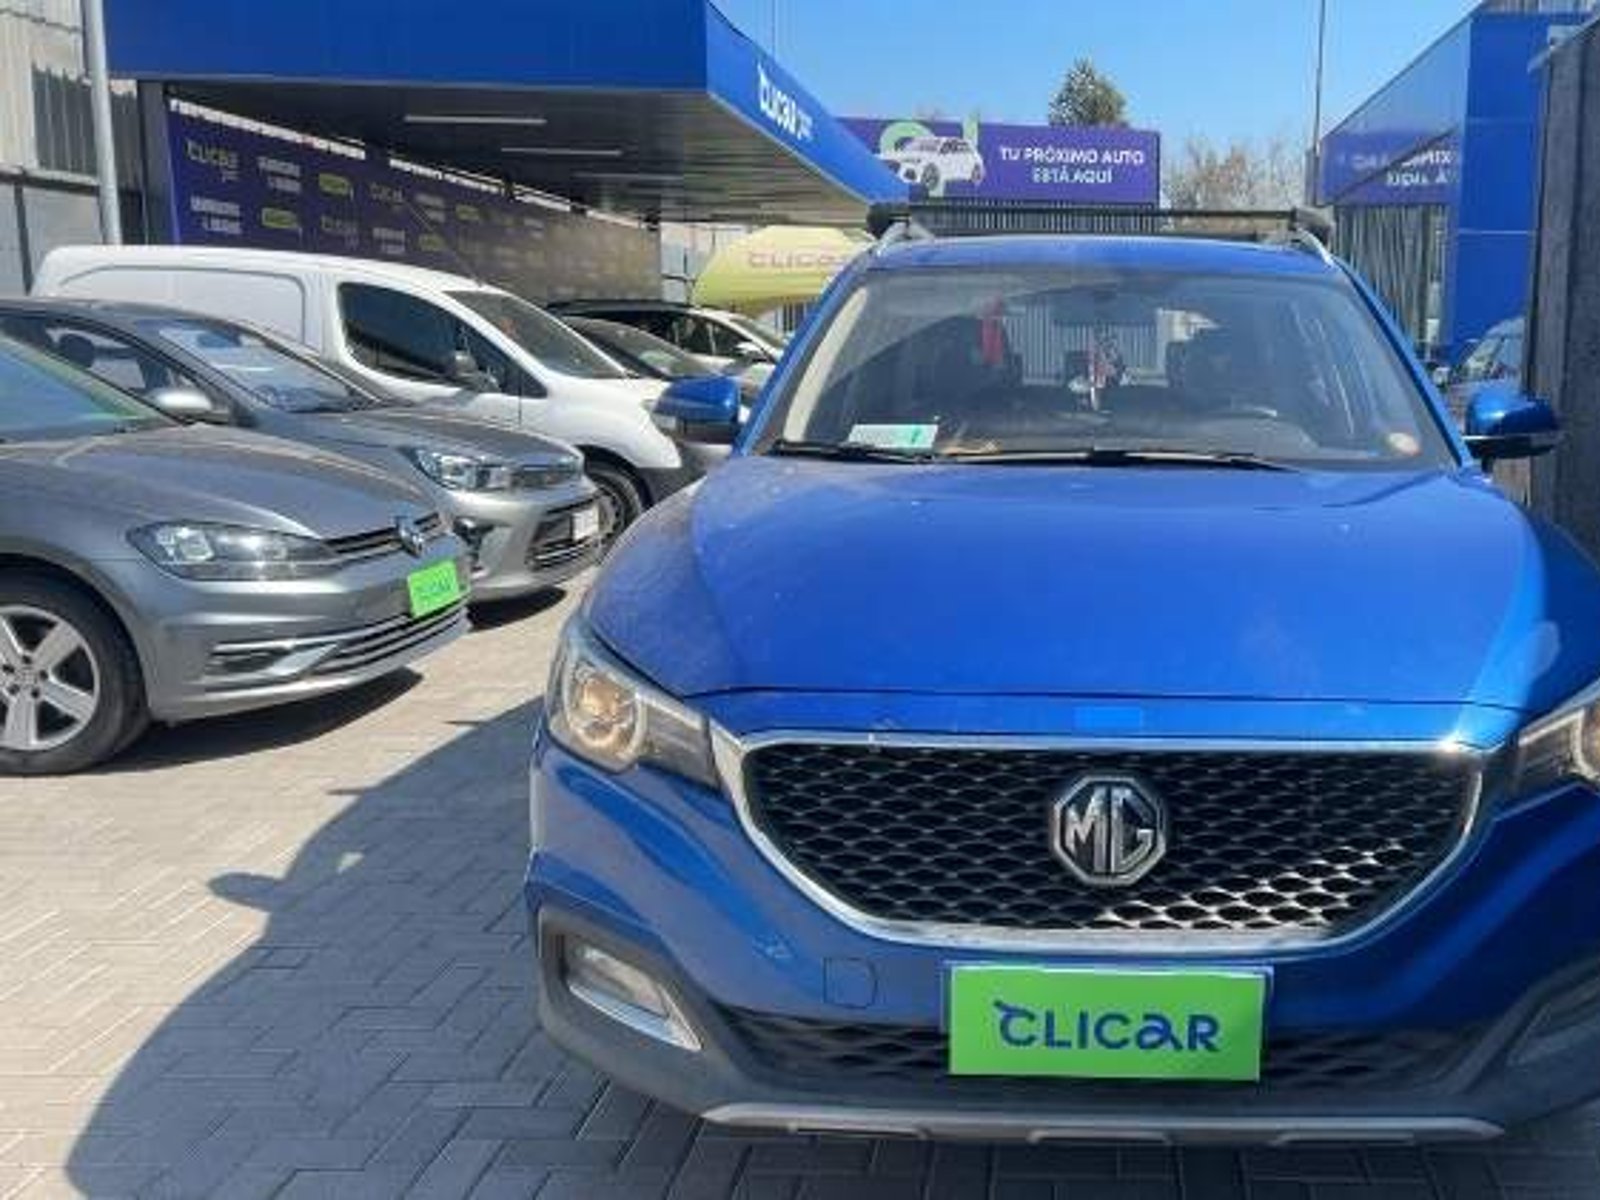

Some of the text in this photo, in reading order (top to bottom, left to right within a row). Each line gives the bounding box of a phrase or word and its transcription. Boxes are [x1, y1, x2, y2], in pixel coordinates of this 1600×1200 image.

[1001, 145, 1145, 166] TU PRÓXIMO AUTO
[1065, 786, 1154, 872] MG
